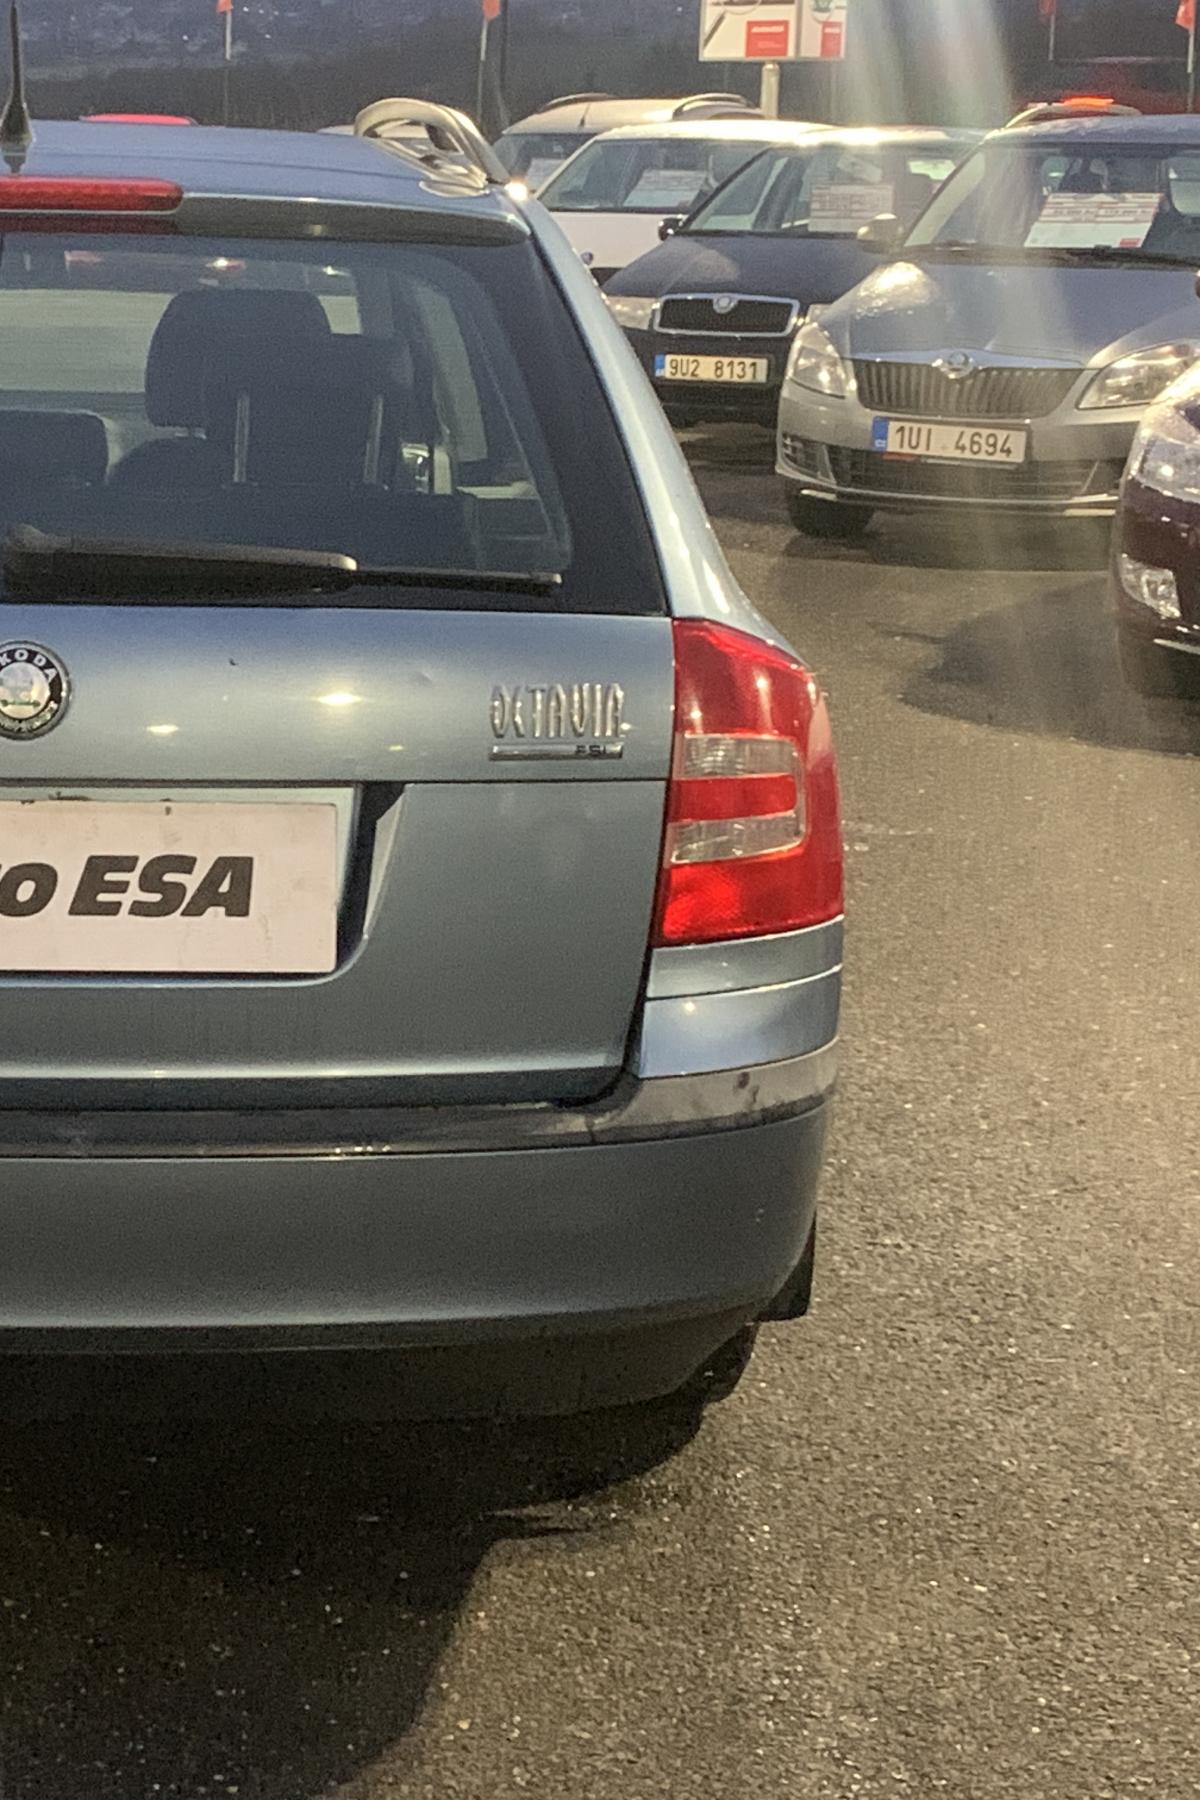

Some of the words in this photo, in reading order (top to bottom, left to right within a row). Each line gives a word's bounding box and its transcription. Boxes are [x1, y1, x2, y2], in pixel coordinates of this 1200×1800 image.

[669, 359, 700, 377] 9U2
[714, 360, 758, 379] 8131
[895, 425, 932, 451] 1UI
[954, 430, 1012, 458] 4694
[490, 682, 625, 738] OCTAVIA
[68, 855, 254, 917] ESA
